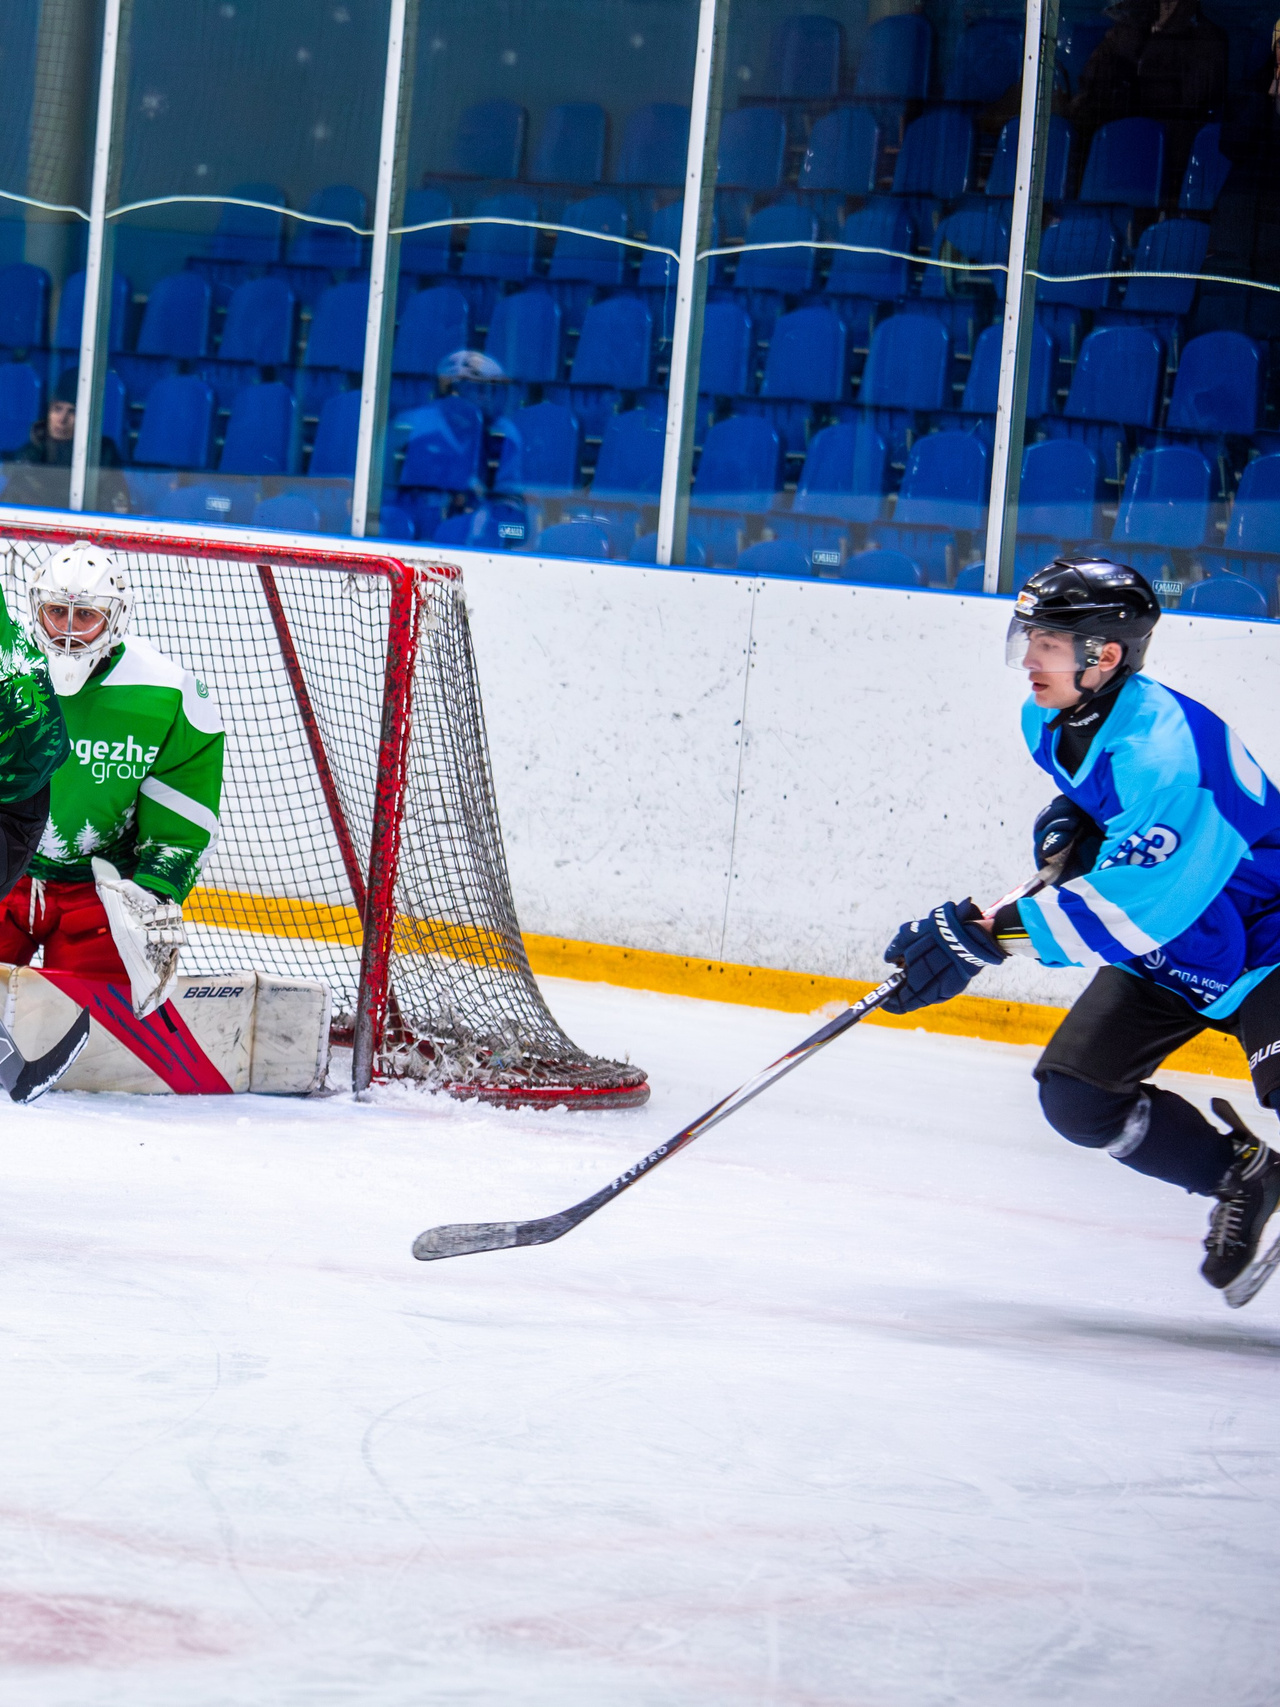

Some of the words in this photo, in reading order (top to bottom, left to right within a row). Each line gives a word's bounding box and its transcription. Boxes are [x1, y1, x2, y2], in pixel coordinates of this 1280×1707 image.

[70, 735, 159, 765] gezha
[92, 762, 153, 784] grou
[183, 986, 244, 999] BAUER
[1249, 1040, 1280, 1071] AUE
